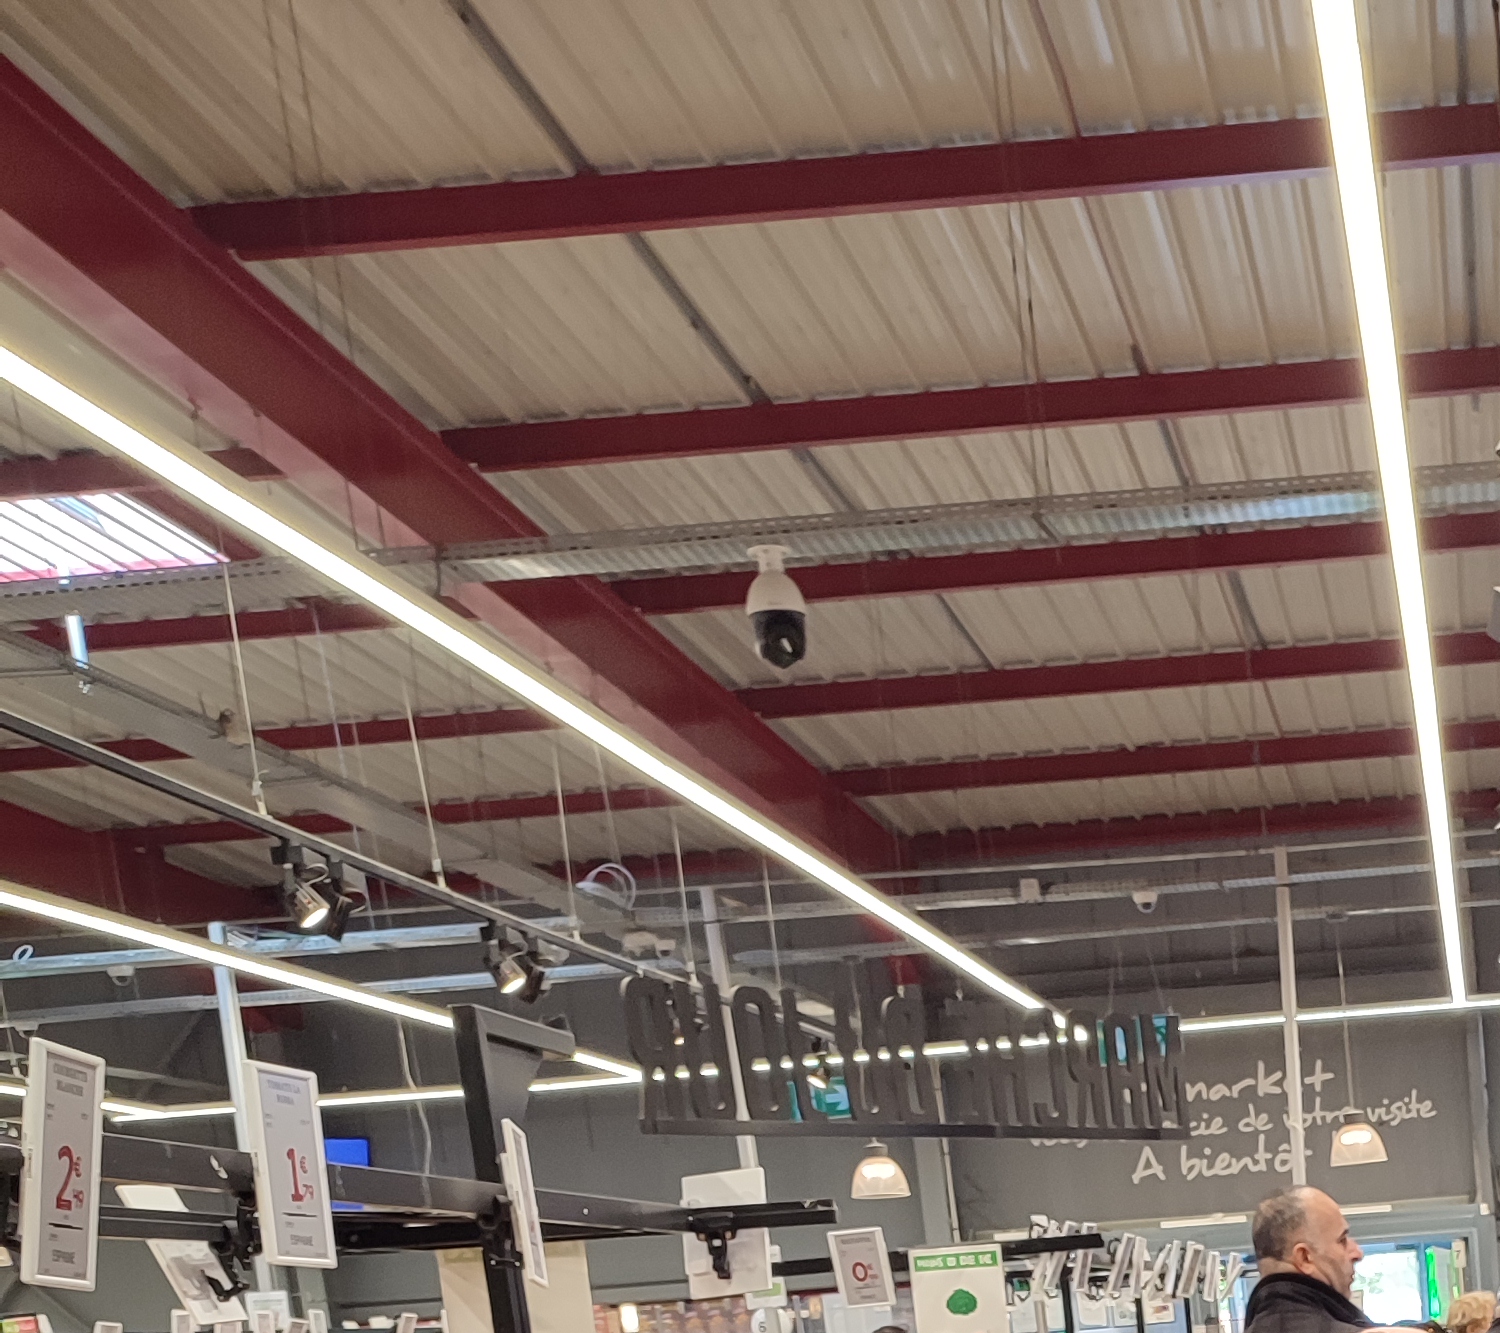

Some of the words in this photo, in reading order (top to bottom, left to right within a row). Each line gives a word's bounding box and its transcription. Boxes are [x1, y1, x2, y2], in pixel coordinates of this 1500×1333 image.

[1238, 1103, 1274, 1133] de
[1366, 1088, 1437, 1126] visite
[1180, 1135, 1313, 1181] bientô
[758, 1321, 767, 1333] 6
